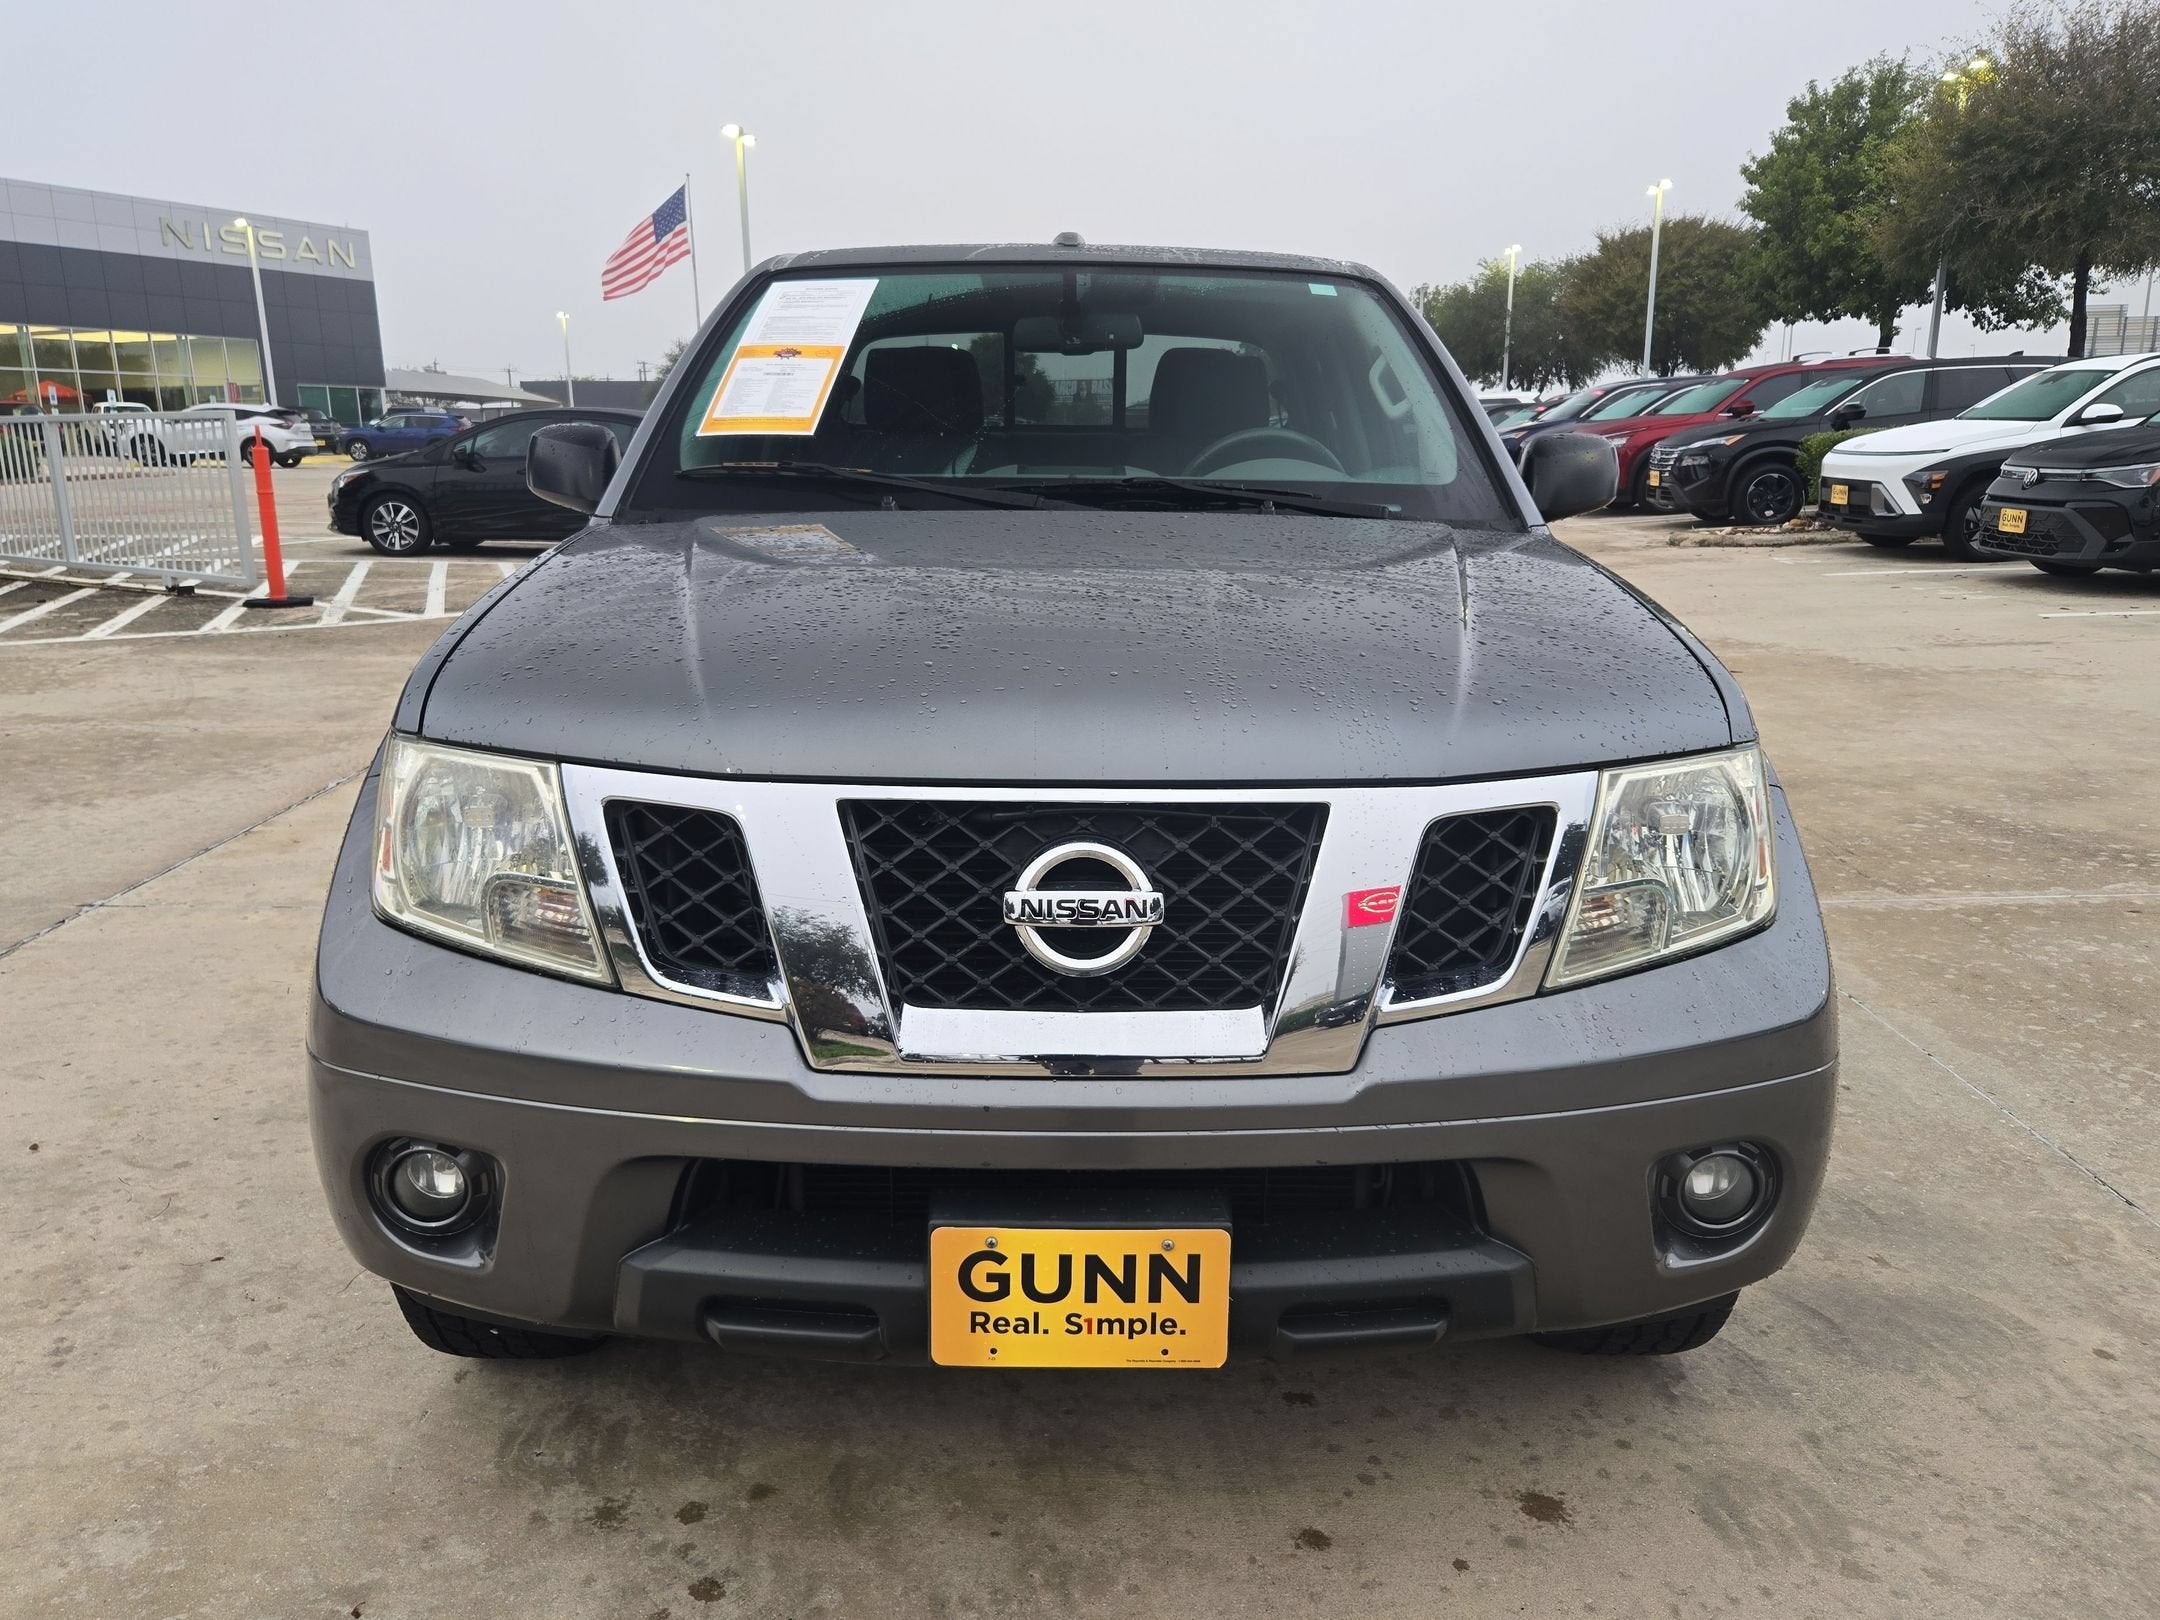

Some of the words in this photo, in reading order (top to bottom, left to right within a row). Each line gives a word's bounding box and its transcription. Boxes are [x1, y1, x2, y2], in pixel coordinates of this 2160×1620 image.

[159, 216, 356, 269] NISSAN
[2002, 513, 2024, 524] GUNN
[1019, 897, 1148, 920] NISSAN
[957, 1249, 1201, 1304] GUNN
[969, 1310, 1049, 1335] Real.
